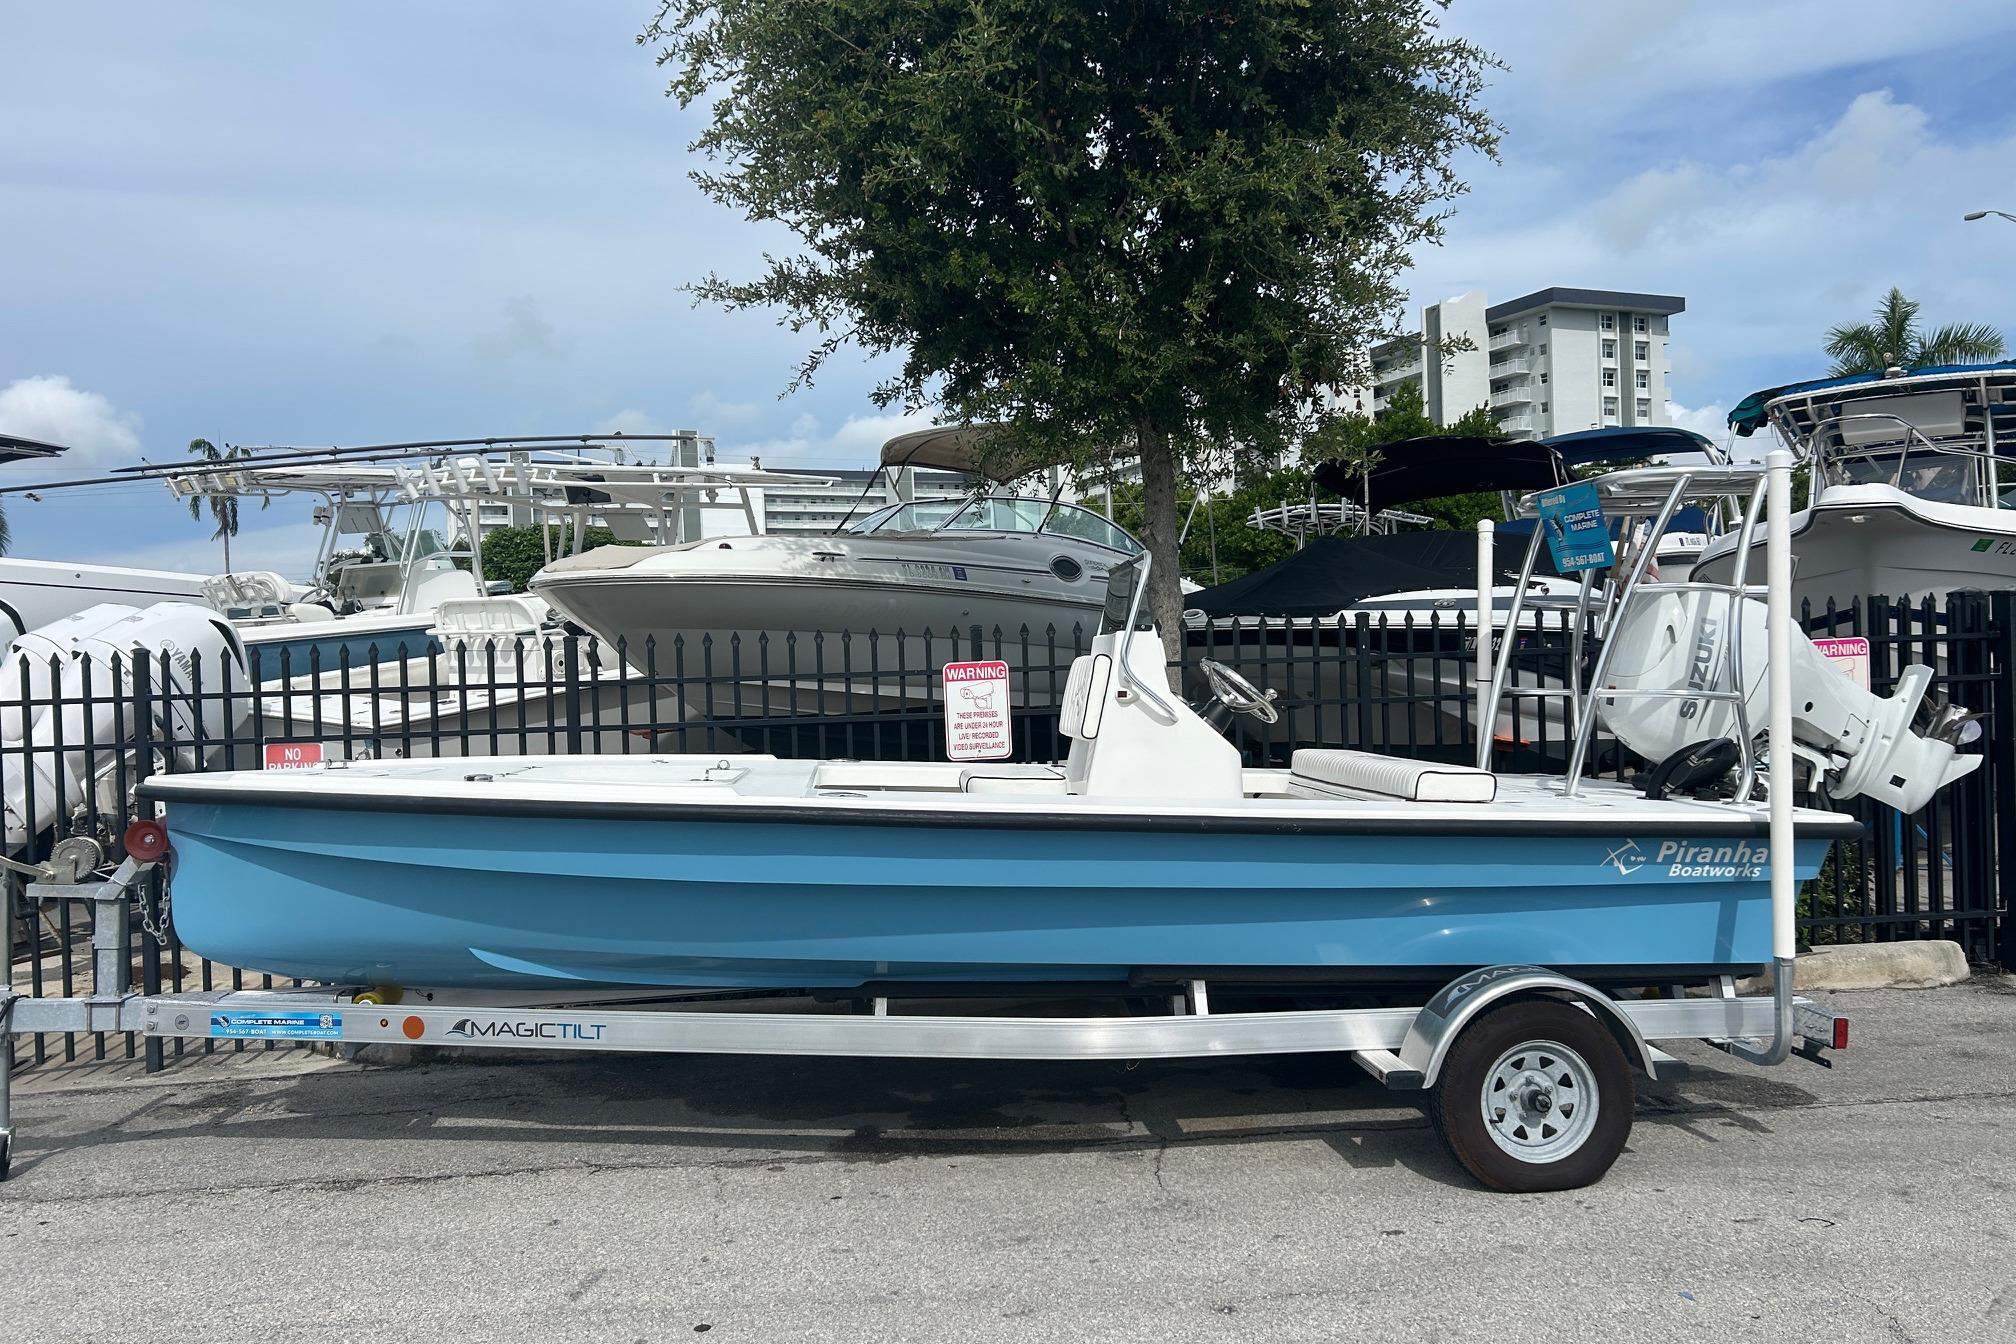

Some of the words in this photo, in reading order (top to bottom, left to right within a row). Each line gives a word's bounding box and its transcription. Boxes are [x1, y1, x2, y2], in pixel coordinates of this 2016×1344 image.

[1563, 509, 1600, 523] COMPLETE
[1570, 519, 1598, 532] MARINE
[1562, 552, 1605, 568] 954-567-BOAT
[946, 666, 1006, 680] WARNING
[956, 712, 972, 720] THESE
[973, 710, 999, 719] PREMISES
[953, 722, 965, 730] ARE
[965, 721, 982, 729] UNDER
[982, 721, 988, 729] 24
[988, 720, 1004, 729] HOUR
[971, 731, 1000, 740] RECORDED
[953, 742, 969, 751] VIDEO
[968, 741, 1006, 751] SURVEILLANCE
[285, 748, 302, 761] NO
[1656, 840, 1769, 863] Piranha
[1668, 863, 1762, 877] Boatworks
[471, 1021, 606, 1039] MAGICTILT
